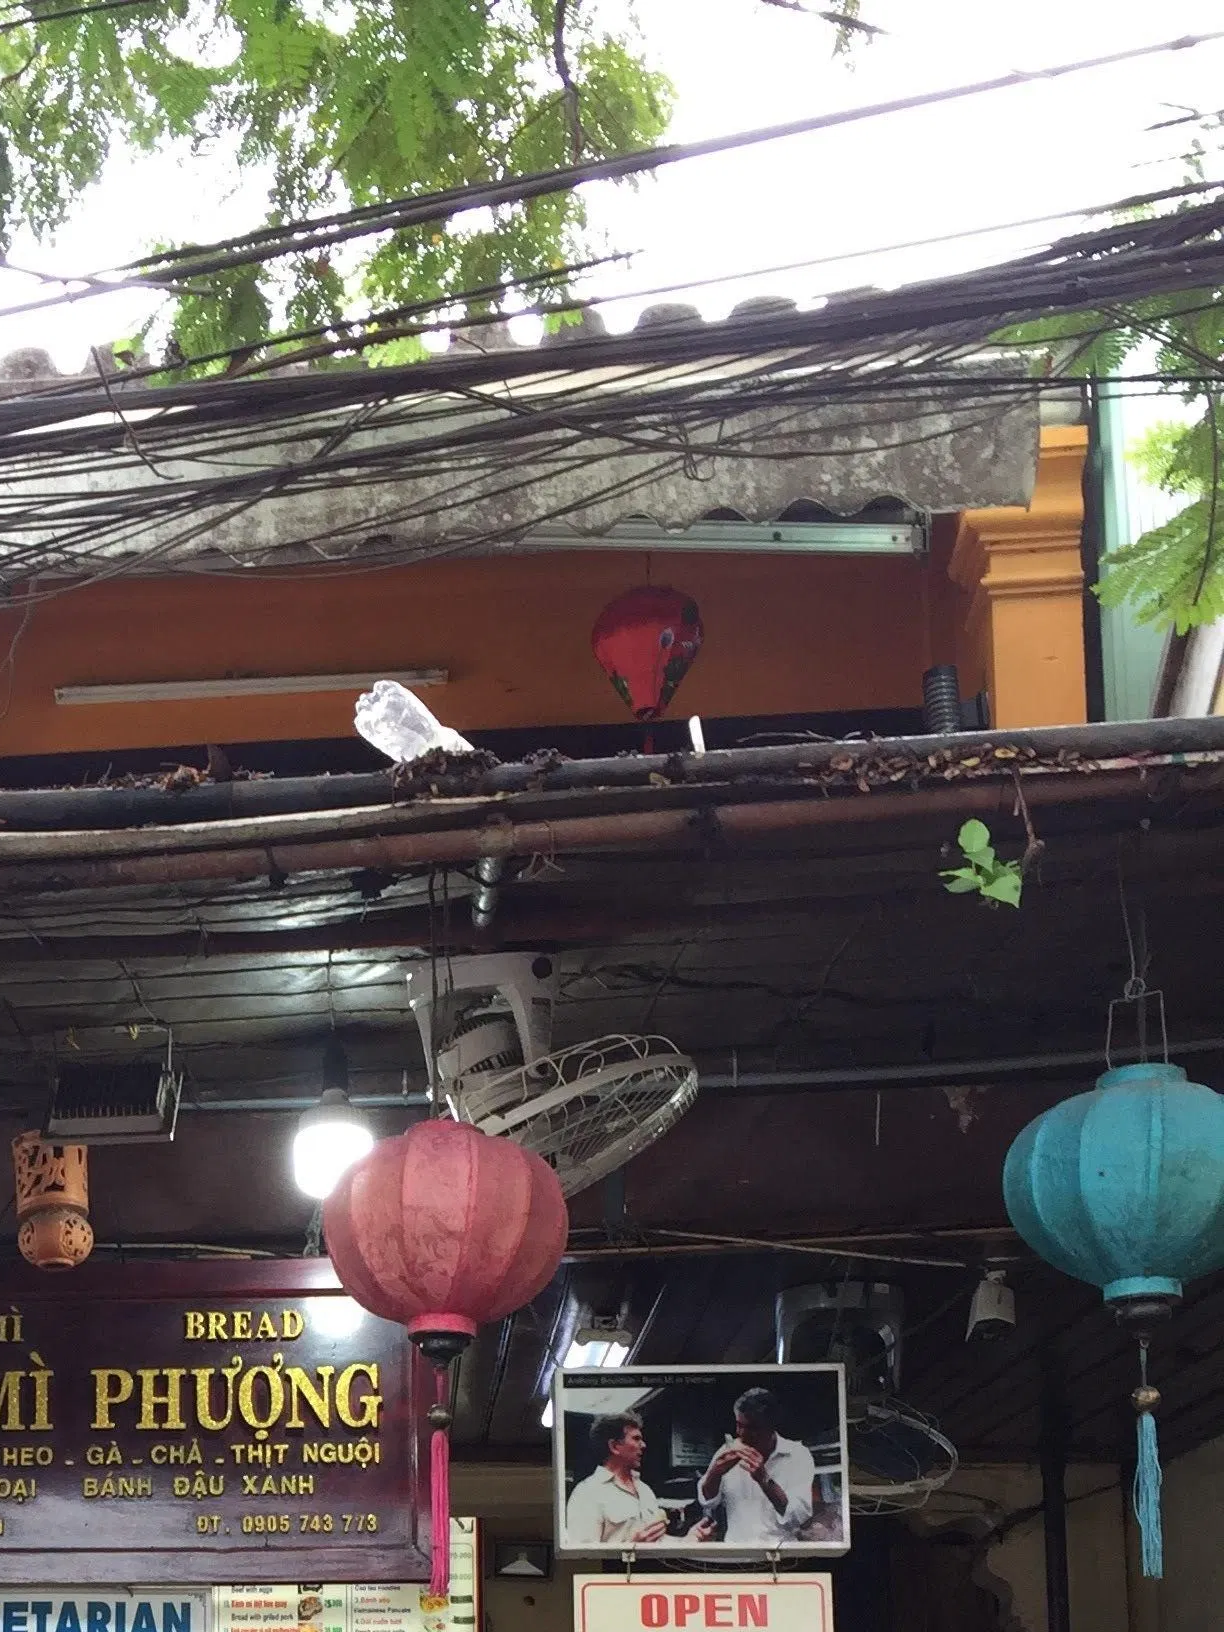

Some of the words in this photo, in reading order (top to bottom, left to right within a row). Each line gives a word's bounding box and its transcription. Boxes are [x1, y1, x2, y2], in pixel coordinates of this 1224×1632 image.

[185, 1310, 306, 1341] BREAD
[90, 1352, 383, 1441] PHƯỢNG
[3, 1446, 54, 1467] HEO
[87, 1441, 123, 1465] GÀ
[151, 1439, 203, 1466] CHẢ
[230, 1443, 289, 1469] THỊT
[303, 1436, 380, 1470] NGUỘI
[84, 1472, 153, 1498] BÁNH
[173, 1470, 225, 1500] ĐẬU
[242, 1475, 315, 1496] XANH
[242, 1514, 291, 1534] 0905
[299, 1514, 334, 1533] 743
[640, 1593, 768, 1629] OPEN
